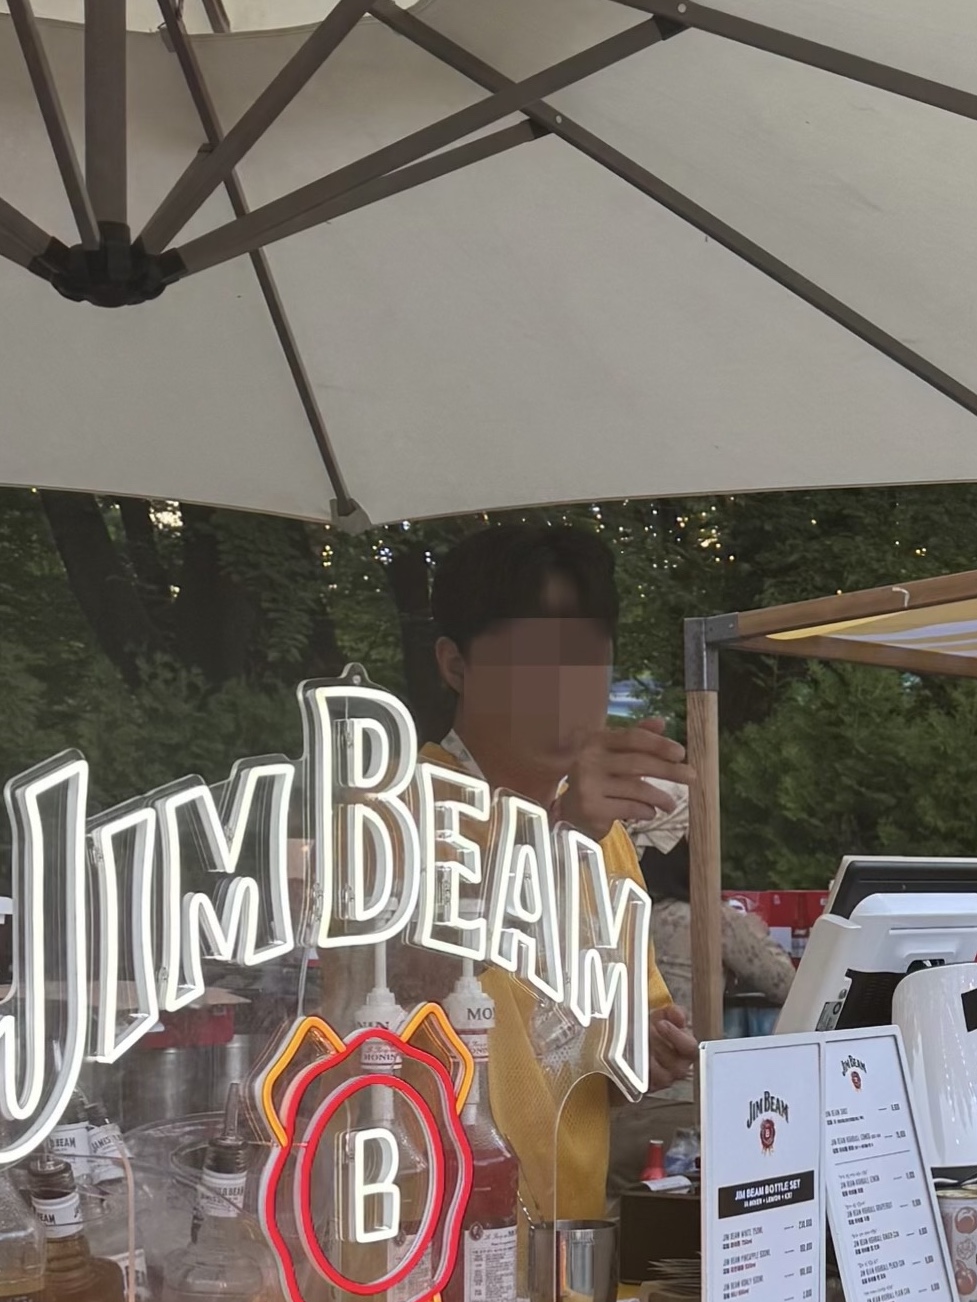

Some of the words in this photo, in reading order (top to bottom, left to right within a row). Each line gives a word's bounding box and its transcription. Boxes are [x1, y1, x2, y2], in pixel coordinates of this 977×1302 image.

[0, 759, 296, 1164] JIM
[315, 686, 650, 1093] BEAM
[467, 1008, 494, 1020] MO
[747, 1098, 763, 1129] JIM
[764, 1091, 789, 1123] BEAM
[354, 1127, 400, 1244] B
[735, 1190, 746, 1201] JIM
[746, 1186, 764, 1198] BEAM
[765, 1182, 789, 1195] BOTTLE
[789, 1179, 801, 1190] SET
